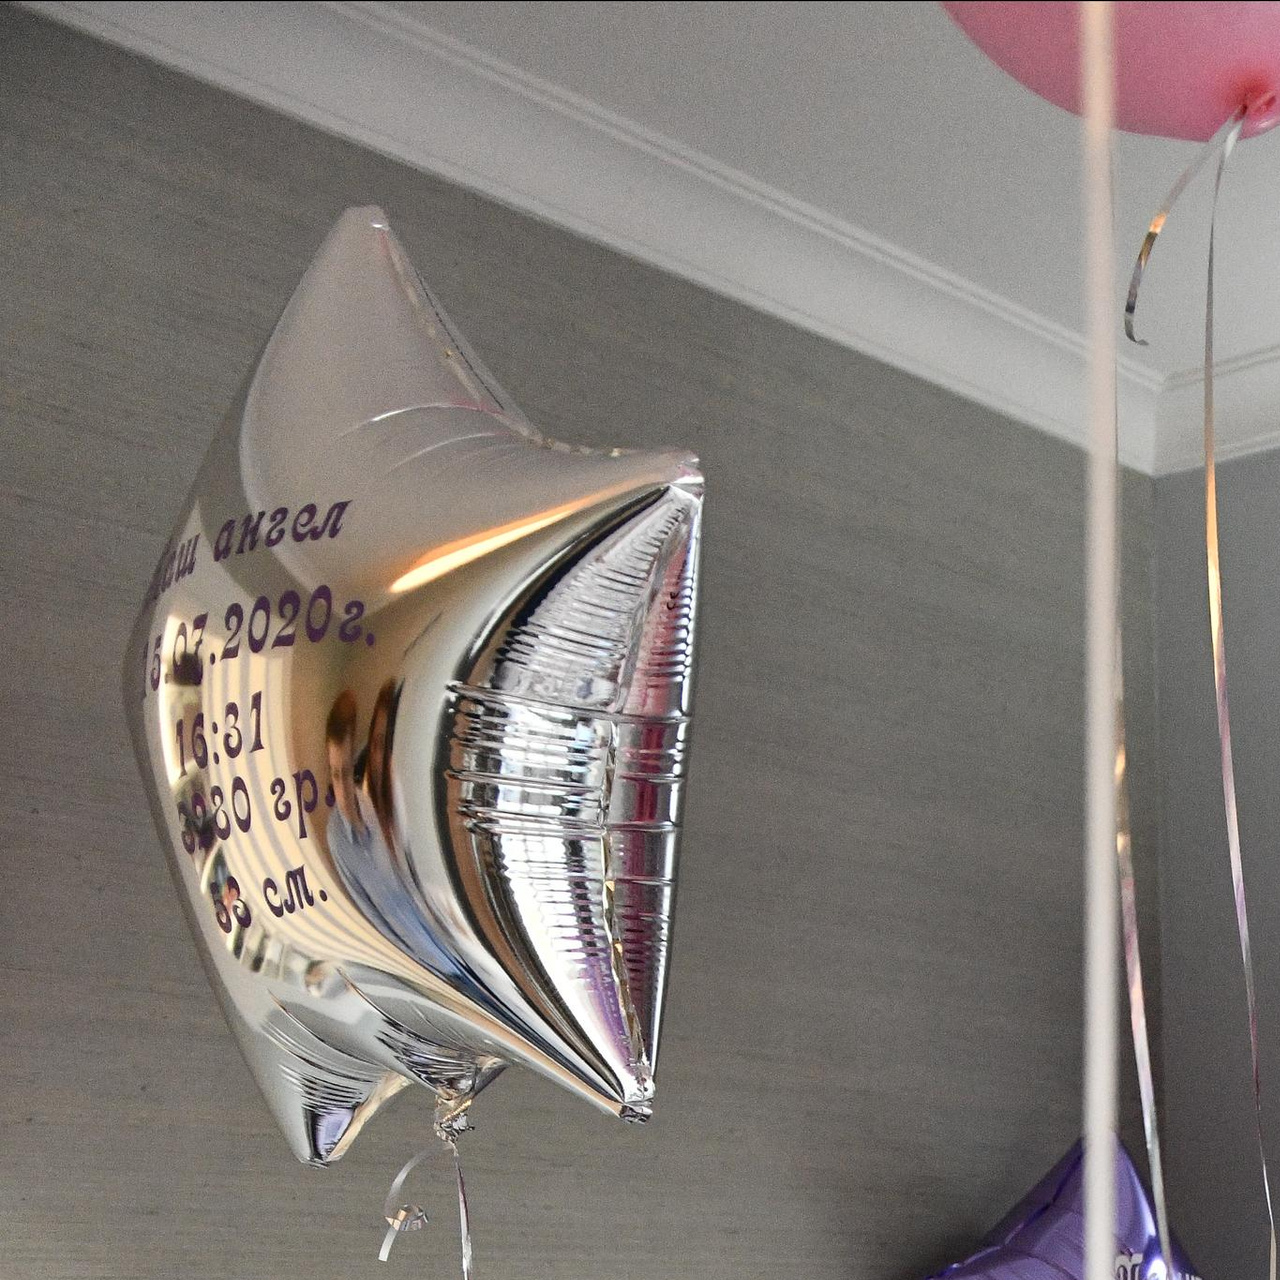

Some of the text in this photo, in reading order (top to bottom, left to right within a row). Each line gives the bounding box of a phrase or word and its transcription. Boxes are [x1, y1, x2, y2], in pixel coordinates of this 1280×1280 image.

[152, 500, 352, 597] аш ангел
[176, 691, 265, 777] 16:31
[270, 769, 336, 838] гр.
[262, 865, 328, 917] см.
